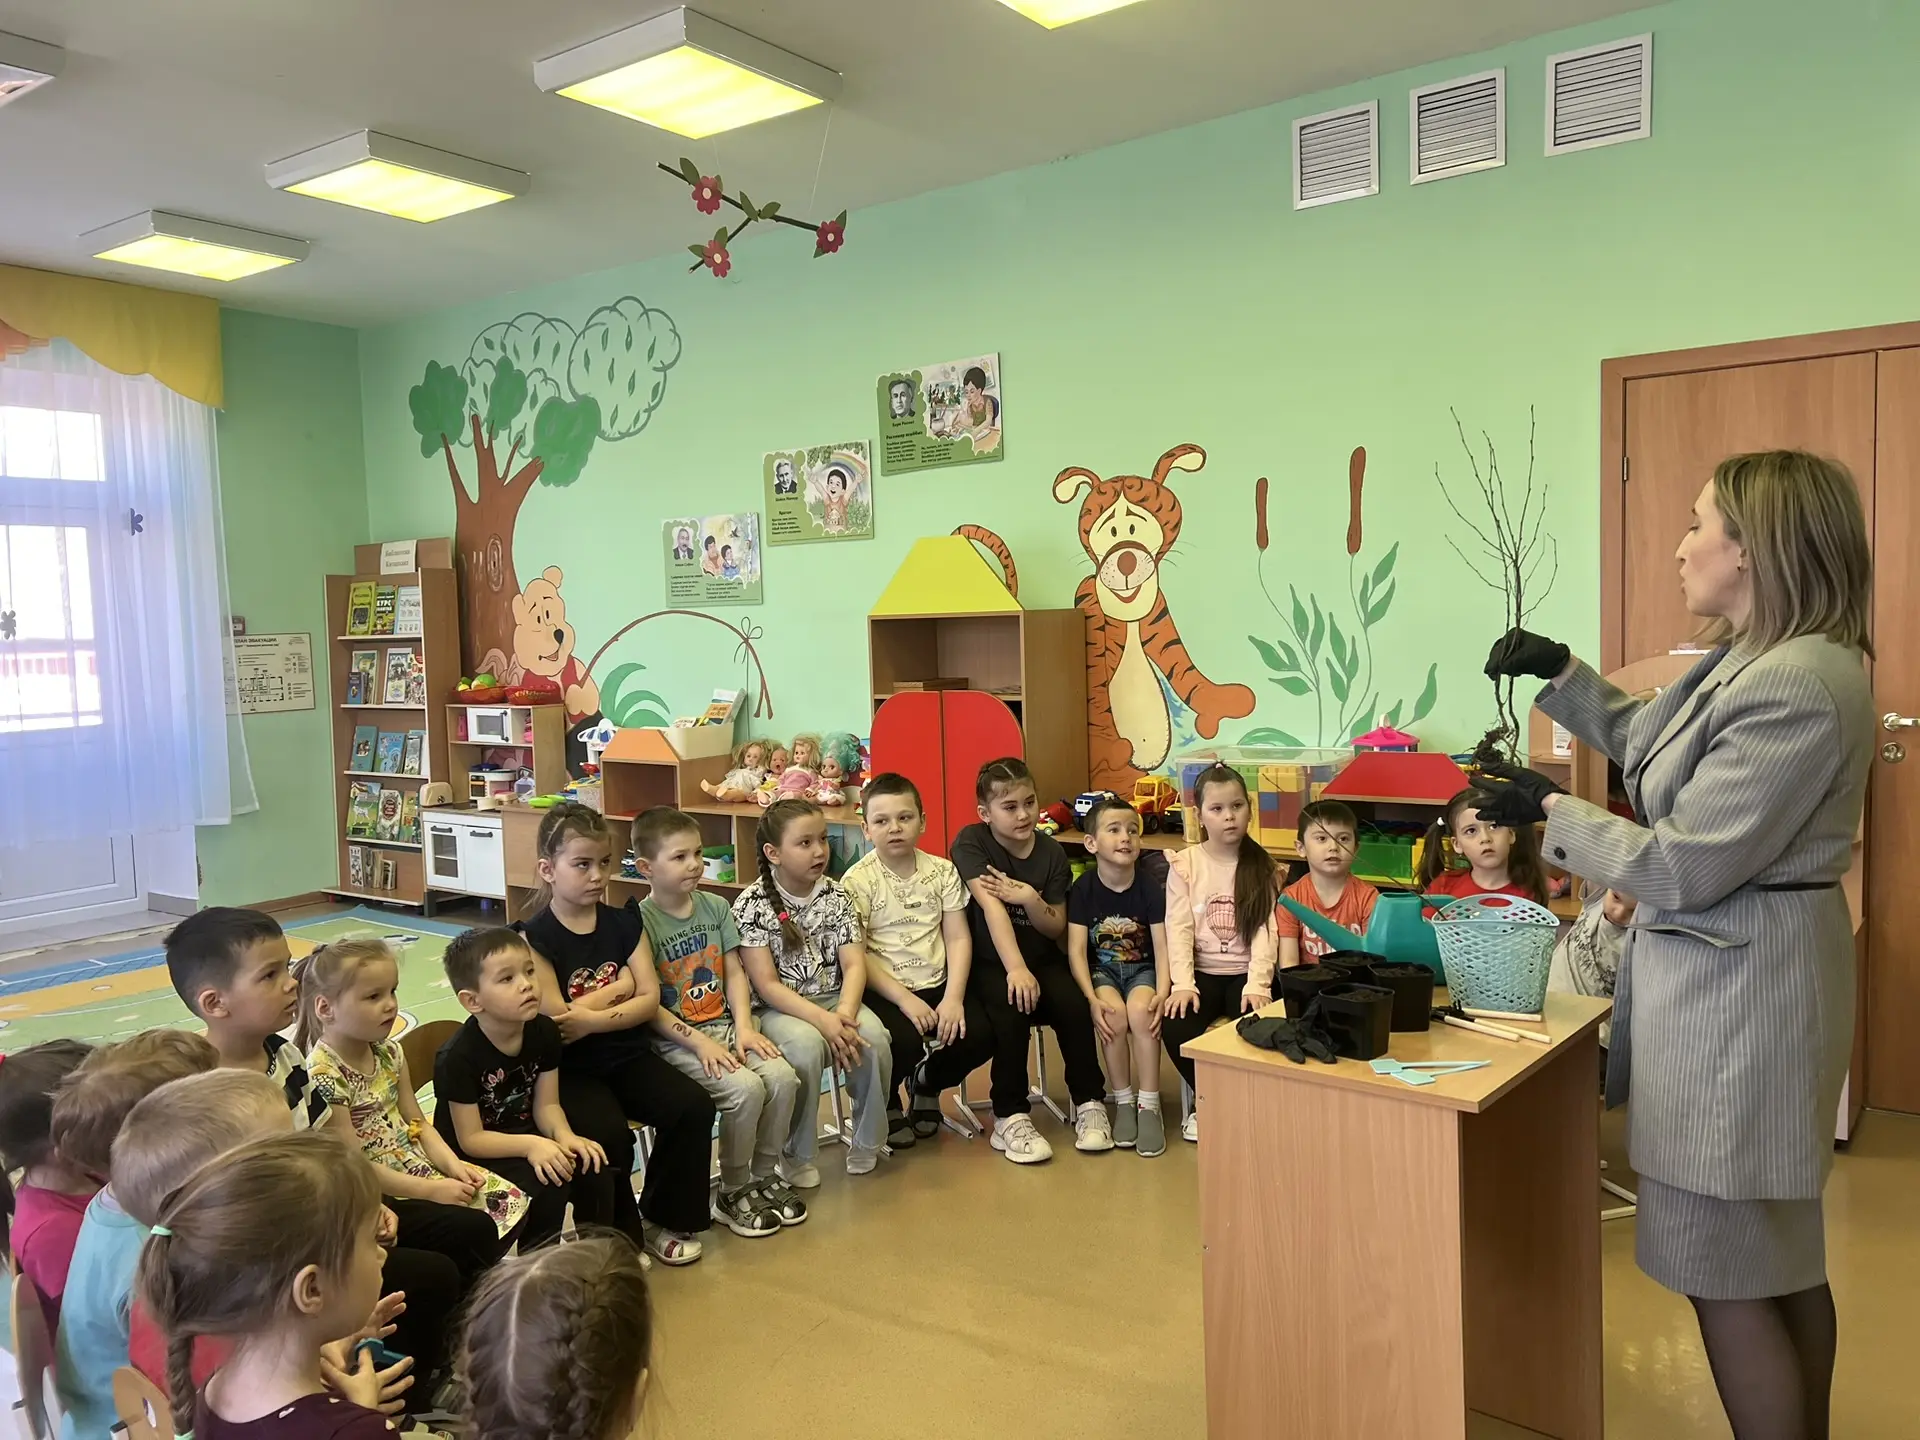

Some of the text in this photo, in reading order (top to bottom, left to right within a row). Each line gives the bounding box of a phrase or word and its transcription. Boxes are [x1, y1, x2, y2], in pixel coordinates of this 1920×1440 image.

[660, 923, 721, 948] AINING SESSION
[664, 932, 708, 963] LEGEND
